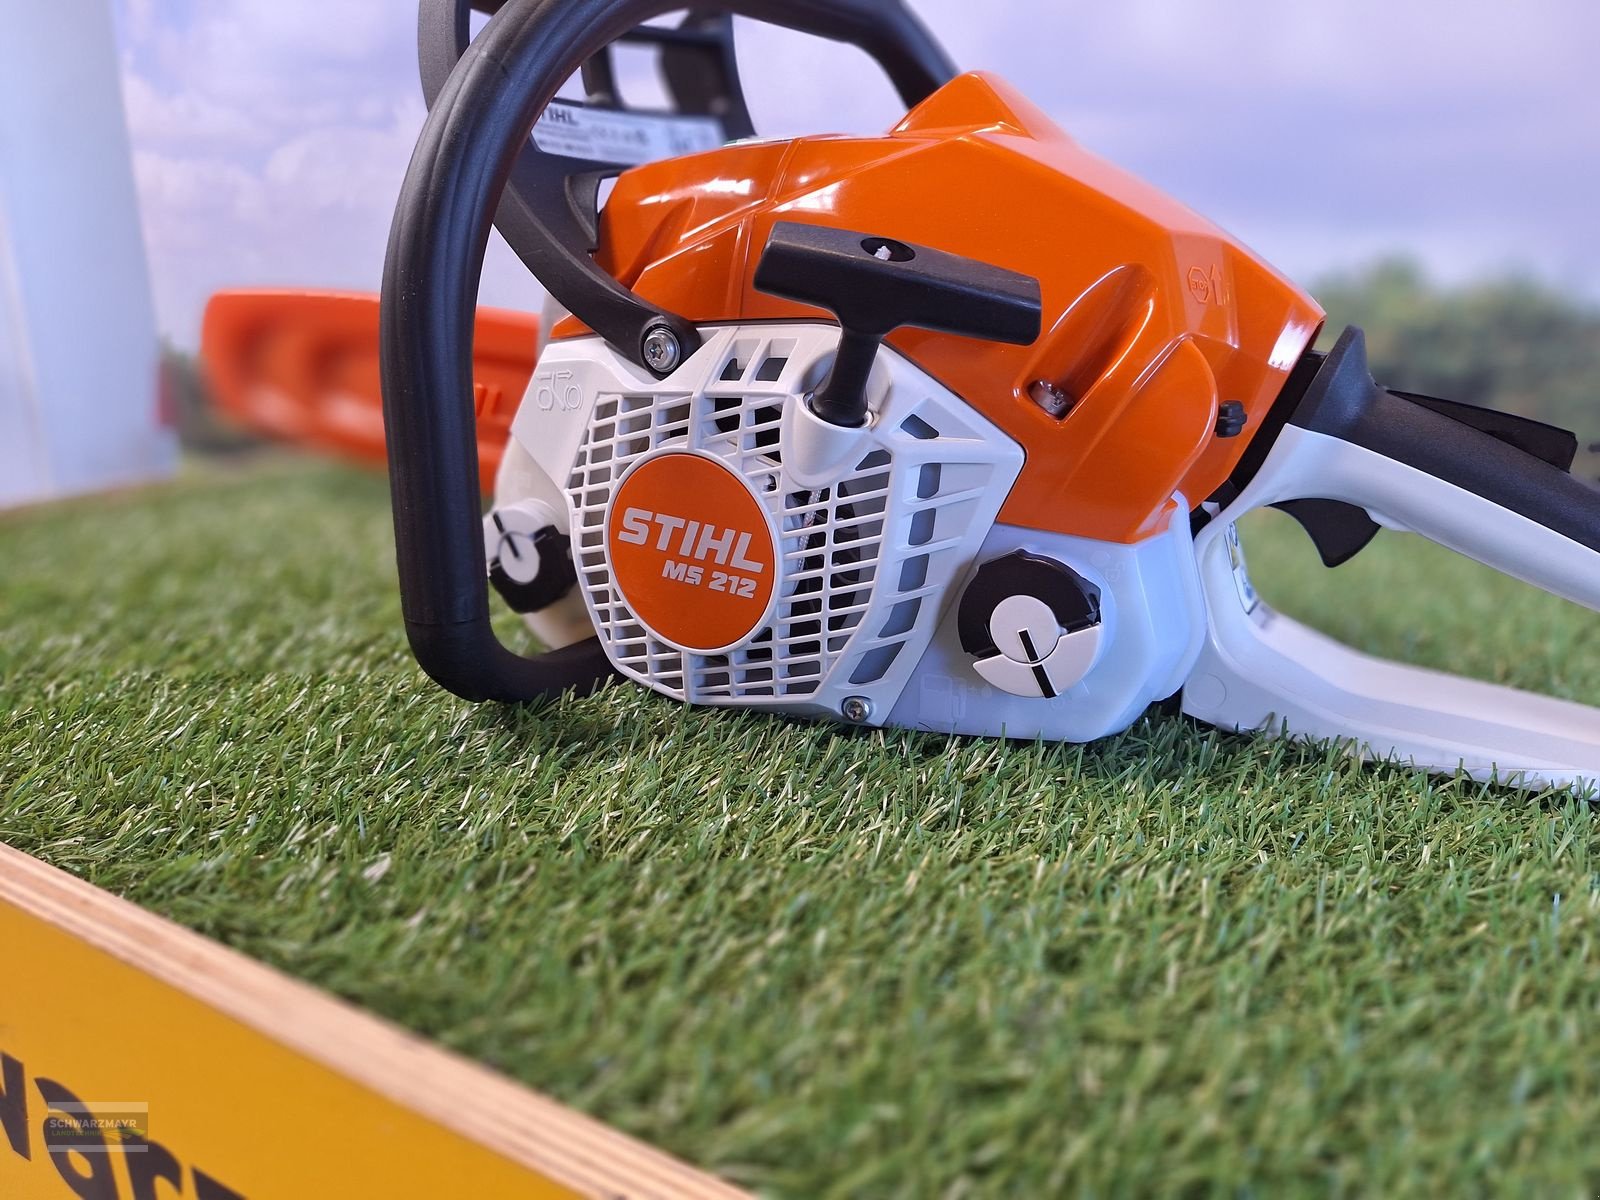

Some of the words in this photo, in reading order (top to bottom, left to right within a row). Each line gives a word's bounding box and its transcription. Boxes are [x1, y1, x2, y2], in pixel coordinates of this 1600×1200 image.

[617, 507, 764, 573] STIHL
[661, 559, 704, 585] MS
[708, 571, 757, 599] 212
